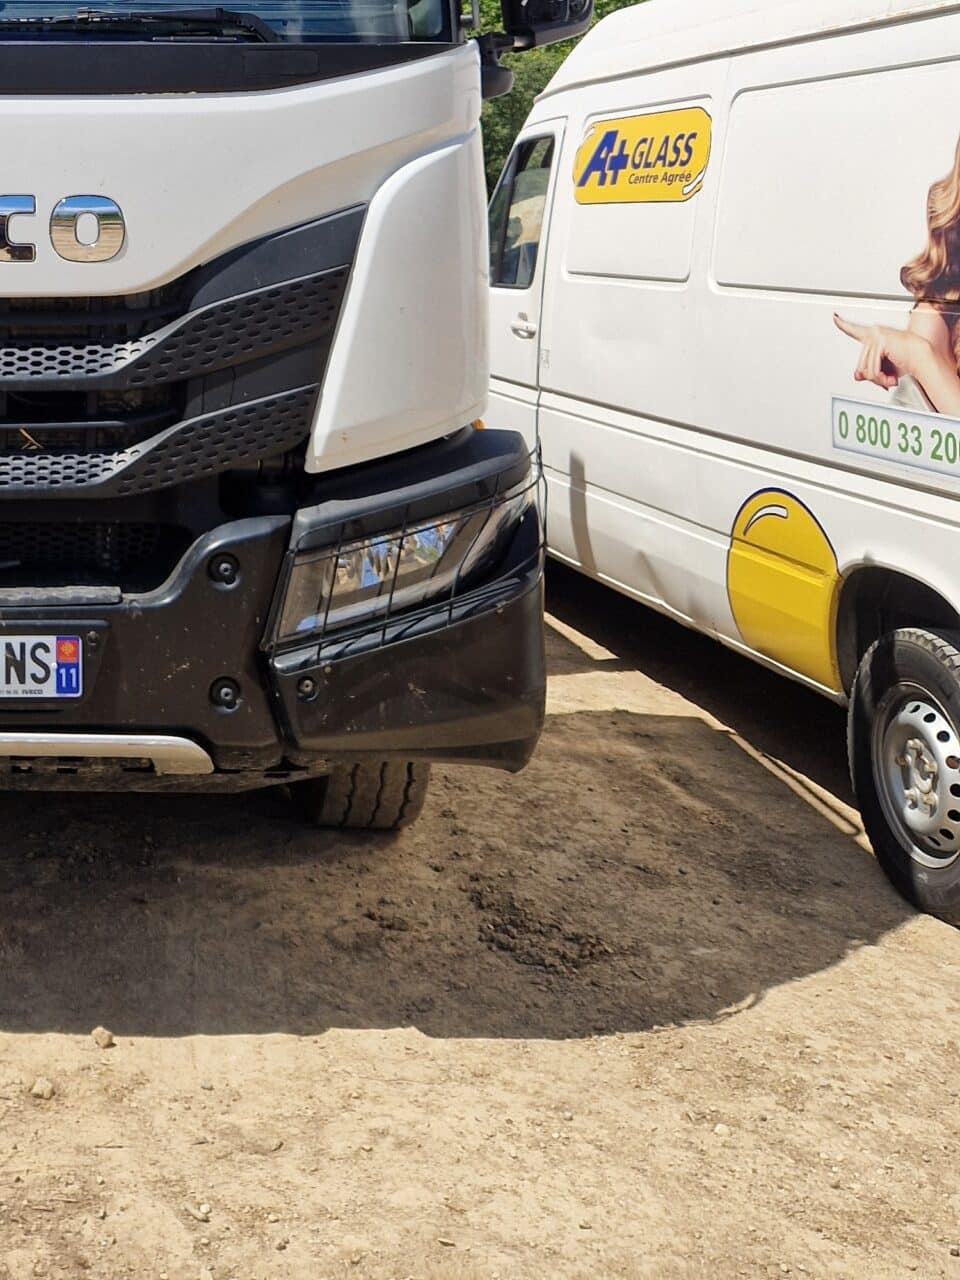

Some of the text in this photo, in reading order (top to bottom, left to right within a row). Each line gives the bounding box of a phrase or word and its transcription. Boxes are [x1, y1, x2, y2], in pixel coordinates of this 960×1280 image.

[631, 133, 697, 169] GLASS
[628, 171, 692, 186] Centre Agréé
[838, 411, 960, 464] 0 800 33 20
[58, 668, 77, 689] 11
[22, 688, 43, 696] IVECO
